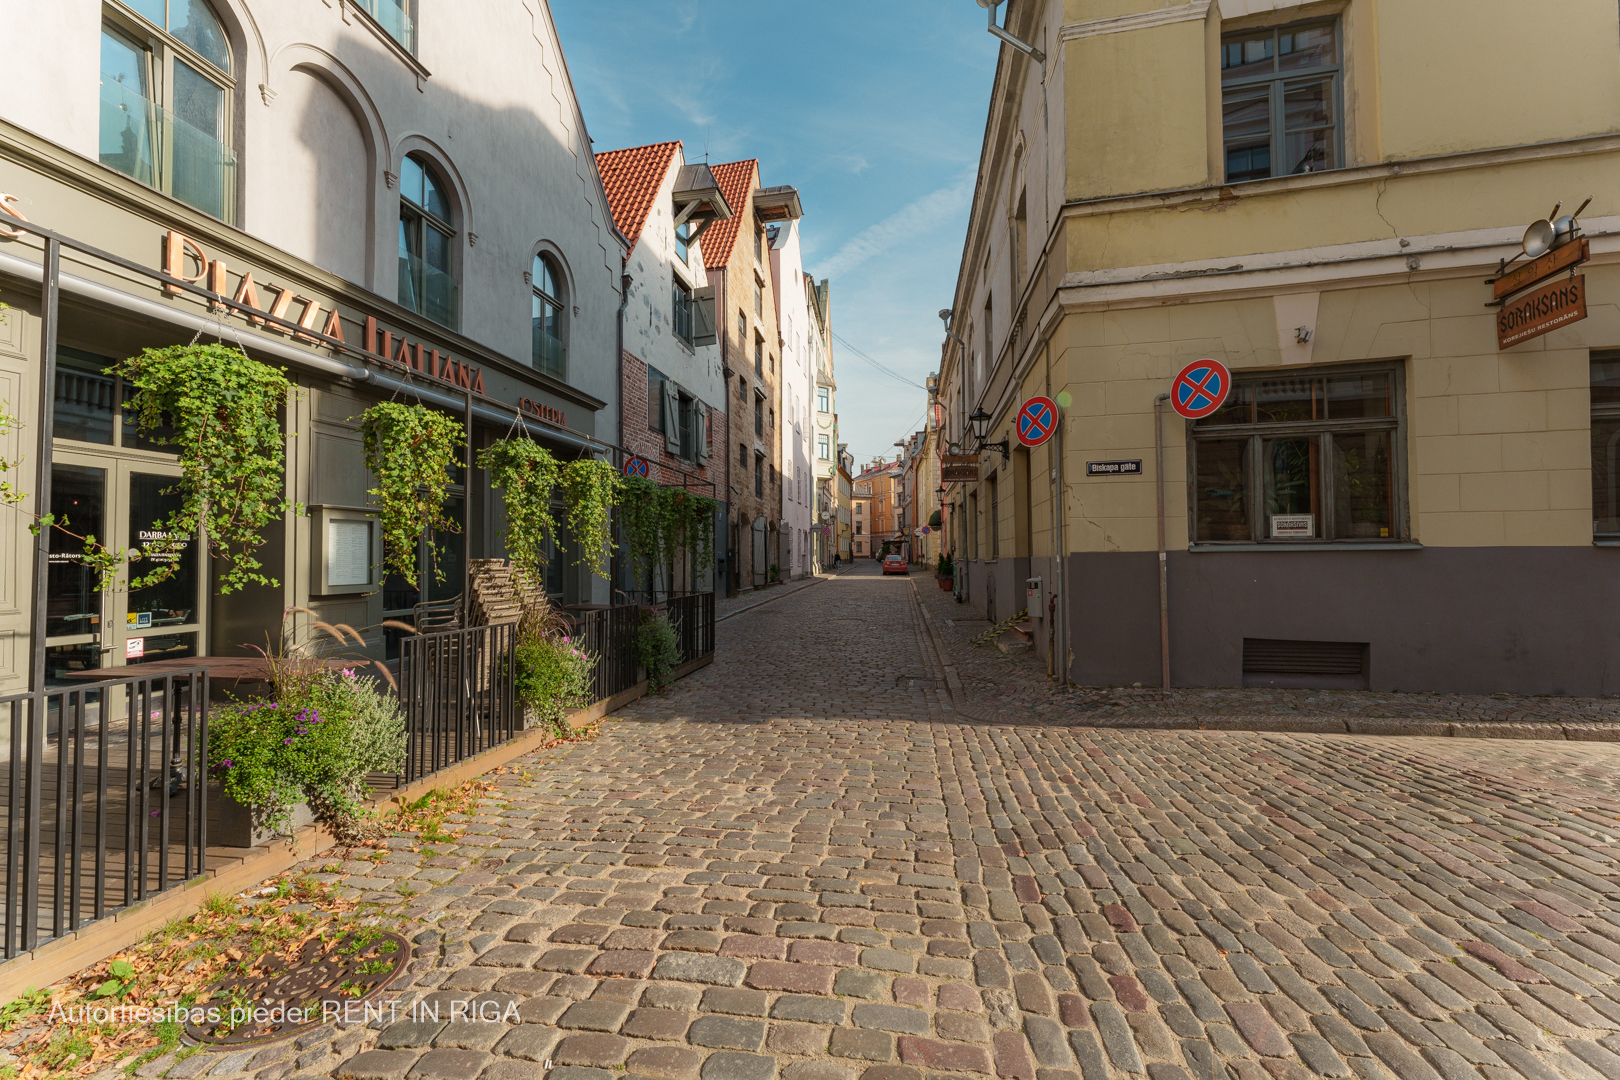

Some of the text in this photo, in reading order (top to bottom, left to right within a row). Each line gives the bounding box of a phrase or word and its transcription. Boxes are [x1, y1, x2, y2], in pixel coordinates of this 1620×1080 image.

[167, 231, 347, 352] PIAZZA
[1500, 285, 1579, 334] SORAKSANS
[1503, 310, 1578, 344] KOREJIEŠU RESTORĀNS
[140, 531, 167, 539] DARBA
